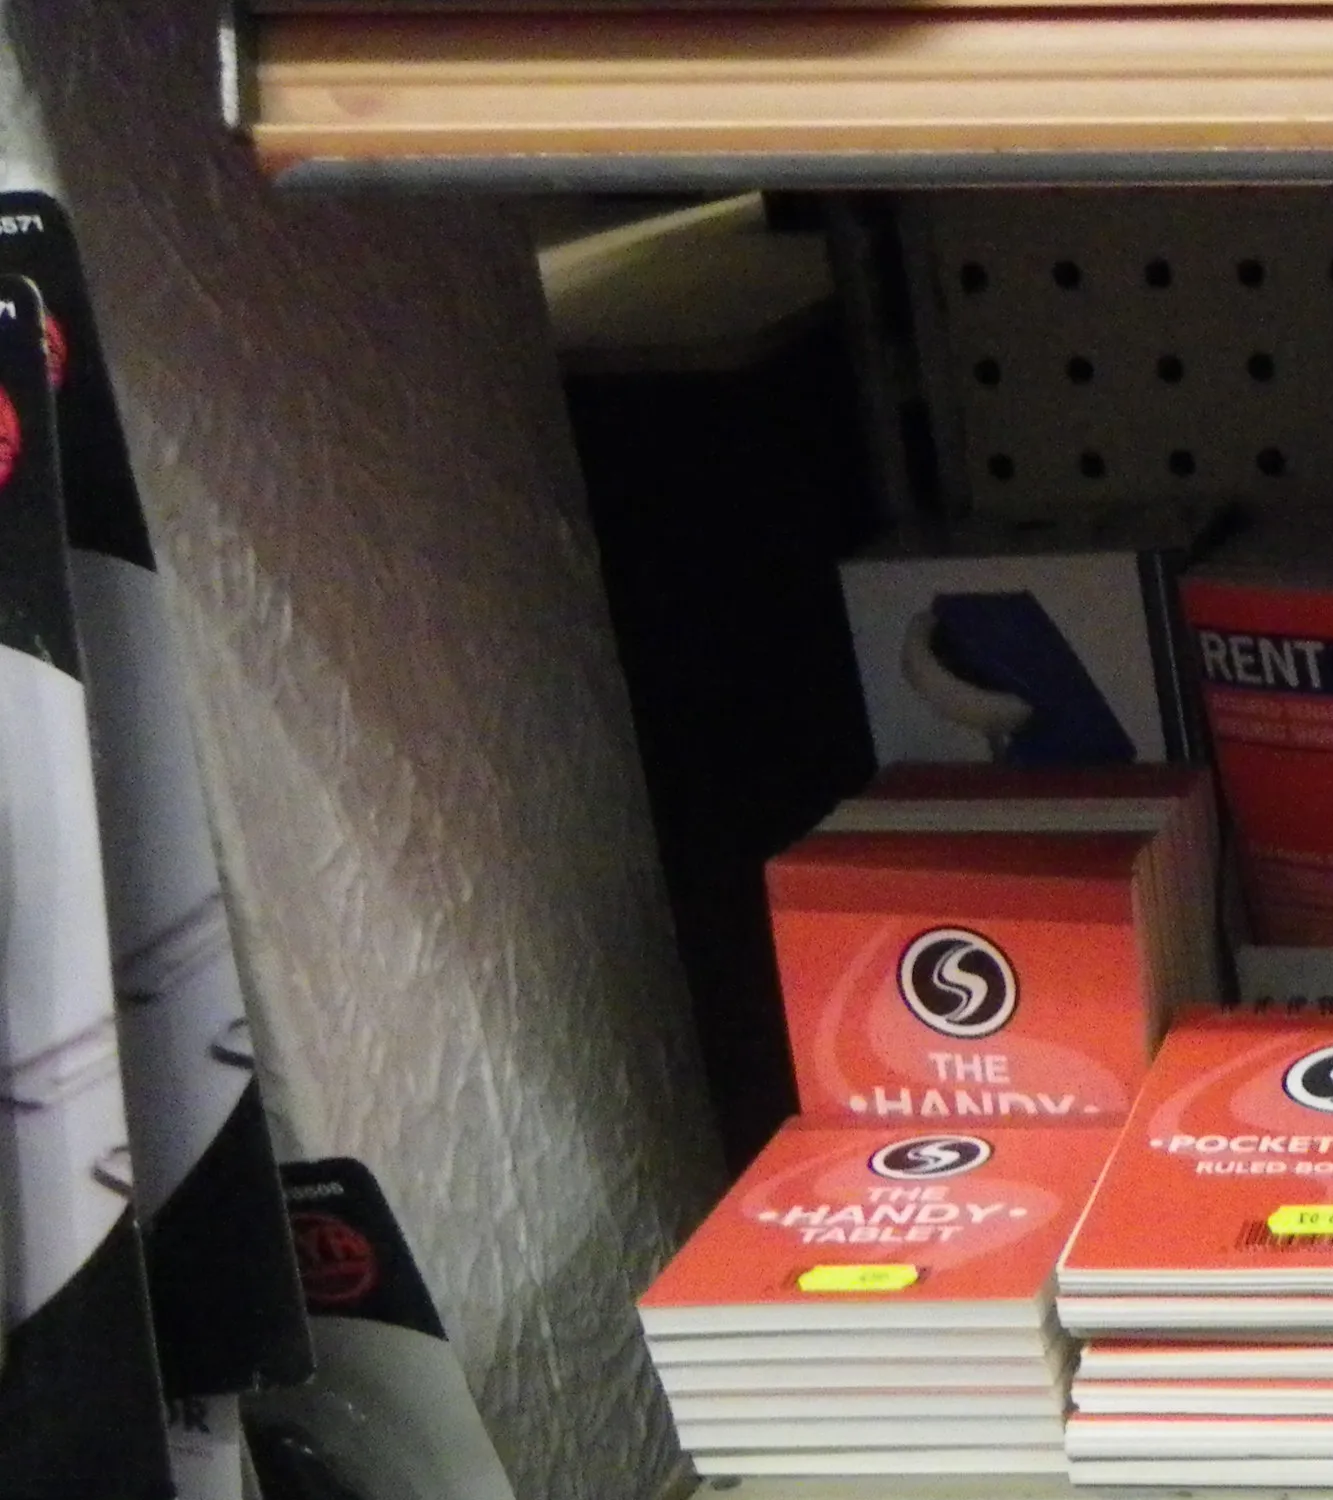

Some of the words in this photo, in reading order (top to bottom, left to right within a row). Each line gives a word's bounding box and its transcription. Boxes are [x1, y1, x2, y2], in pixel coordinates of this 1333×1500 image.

[0, 214, 45, 234] 571
[1200, 631, 1325, 689] RENT
[928, 1051, 1011, 1083] THE
[1195, 1160, 1287, 1175] RULED
[866, 1185, 949, 1202] THE
[782, 1204, 998, 1227] HANDY
[800, 1224, 966, 1245] TABLET
